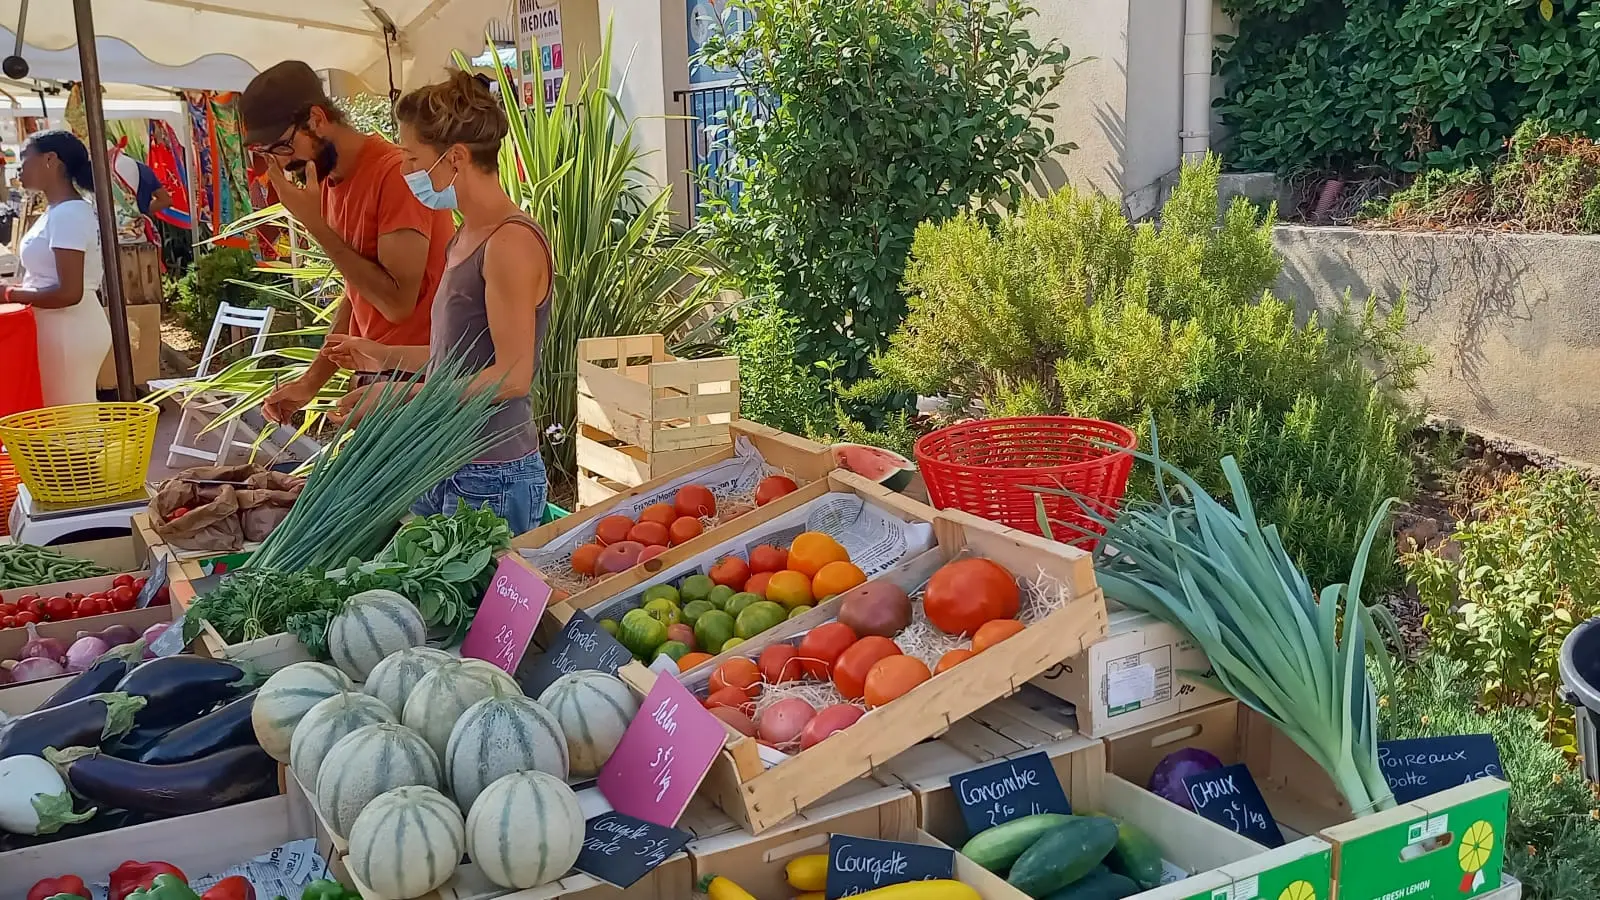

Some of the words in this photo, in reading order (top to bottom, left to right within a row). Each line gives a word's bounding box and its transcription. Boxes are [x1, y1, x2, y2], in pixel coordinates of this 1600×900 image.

[521, 9, 558, 33] MEDICAL
[567, 619, 599, 653] Tomates
[960, 764, 1040, 806] Concombre
[1191, 774, 1241, 808] CHOUX
[593, 816, 650, 841] Courgette
[835, 844, 908, 885] Courgette
[1381, 887, 1405, 900] FRESH
[1405, 879, 1431, 896] LEMON
